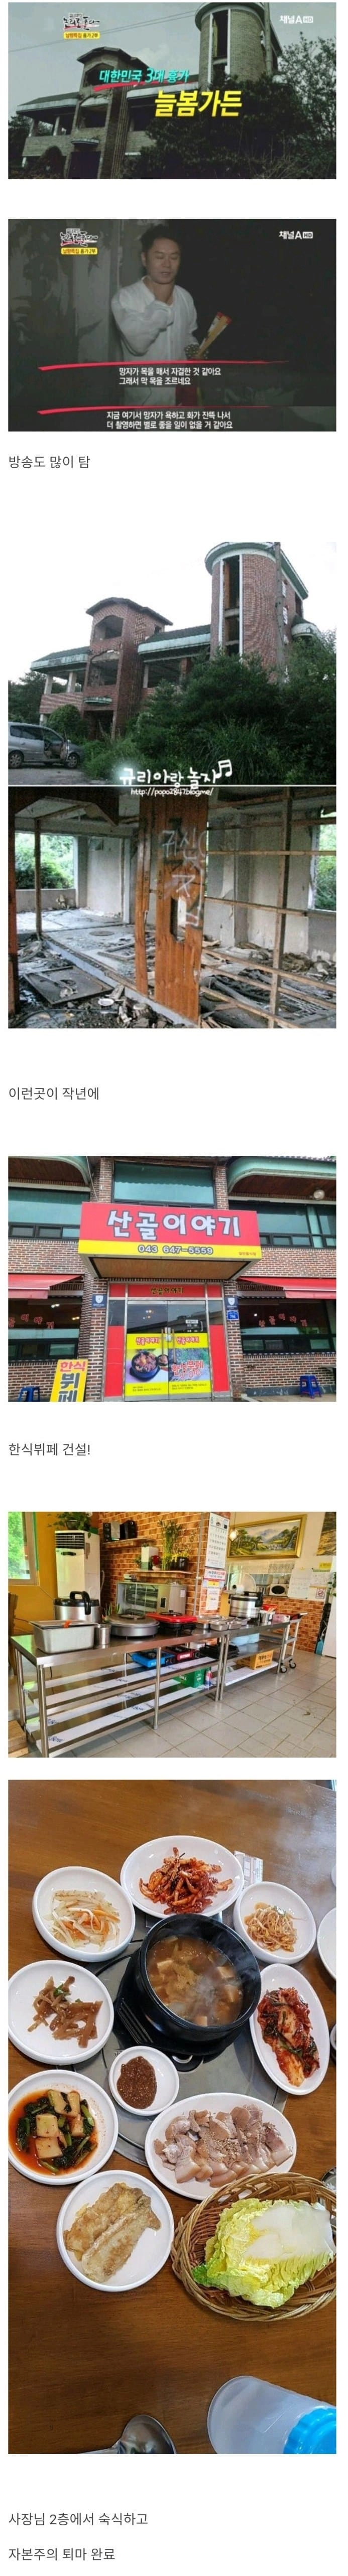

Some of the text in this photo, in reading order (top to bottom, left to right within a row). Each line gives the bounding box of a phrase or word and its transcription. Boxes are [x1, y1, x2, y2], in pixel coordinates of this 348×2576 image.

[107, 1209, 241, 1241] 산골이야기
[138, 1245, 213, 1255] 043 647-5559
[136, 1337, 160, 1345] 산골이야기
[177, 1336, 200, 1345] 산골이야기
[60, 1361, 86, 1372] 한식
[58, 1372, 80, 1402] 뷔페
